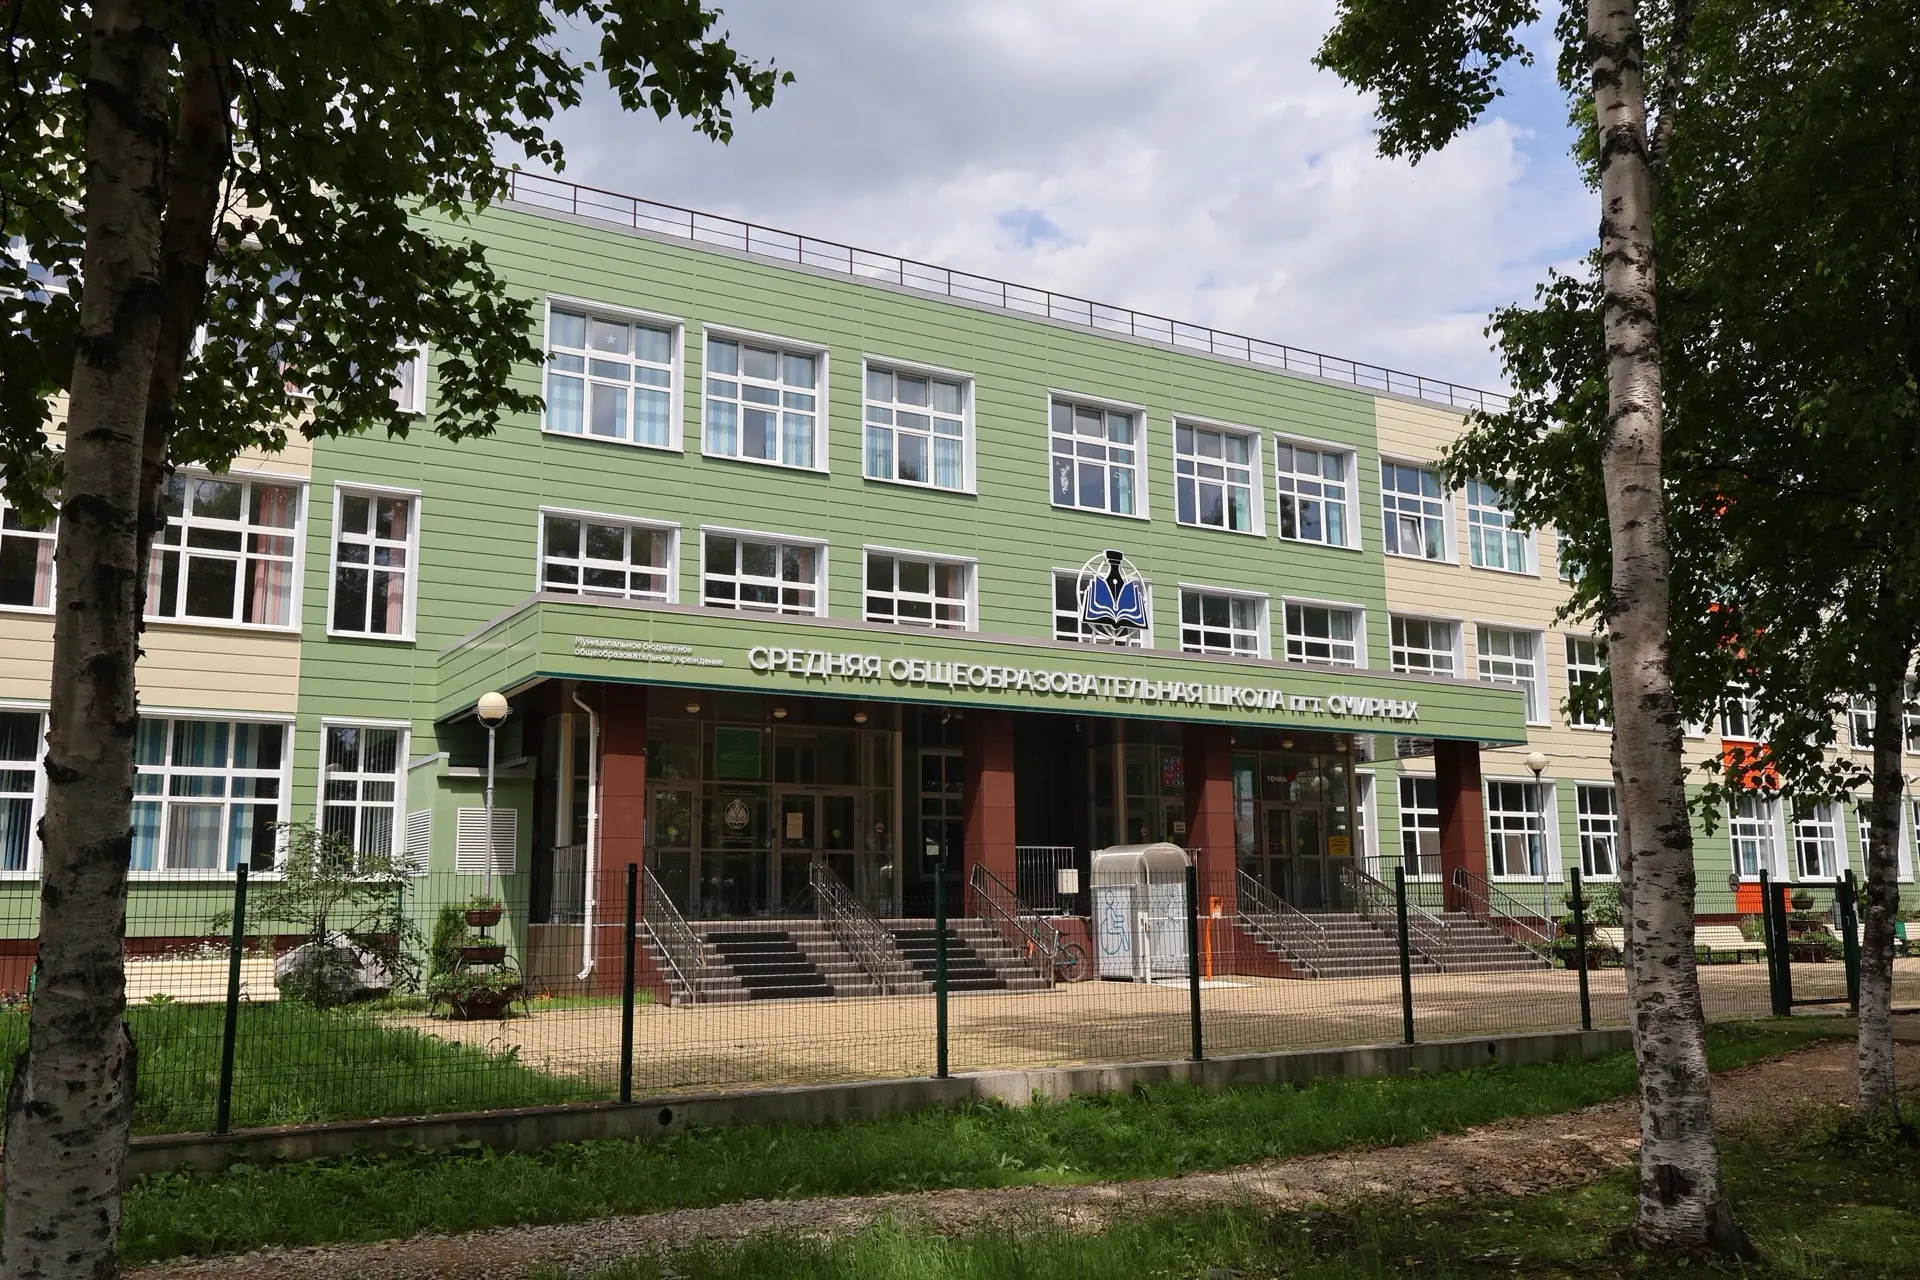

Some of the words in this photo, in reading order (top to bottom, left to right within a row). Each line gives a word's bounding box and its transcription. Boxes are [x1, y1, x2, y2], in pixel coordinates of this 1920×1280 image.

[574, 636, 642, 649] Муниципальное
[643, 642, 693, 653] бюджетное
[574, 648, 671, 662] общеобразовательное
[672, 656, 724, 667] учреждение
[749, 646, 882, 679] СРЕДНЯЯ
[889, 658, 1203, 703] ОБЩЕОБРАЗОВАТЕЛЬНАЯ
[1207, 684, 1286, 710] ШКОЛА
[1328, 695, 1420, 720] СМИРНЫХ
[1267, 775, 1287, 783] ТОЧКА
